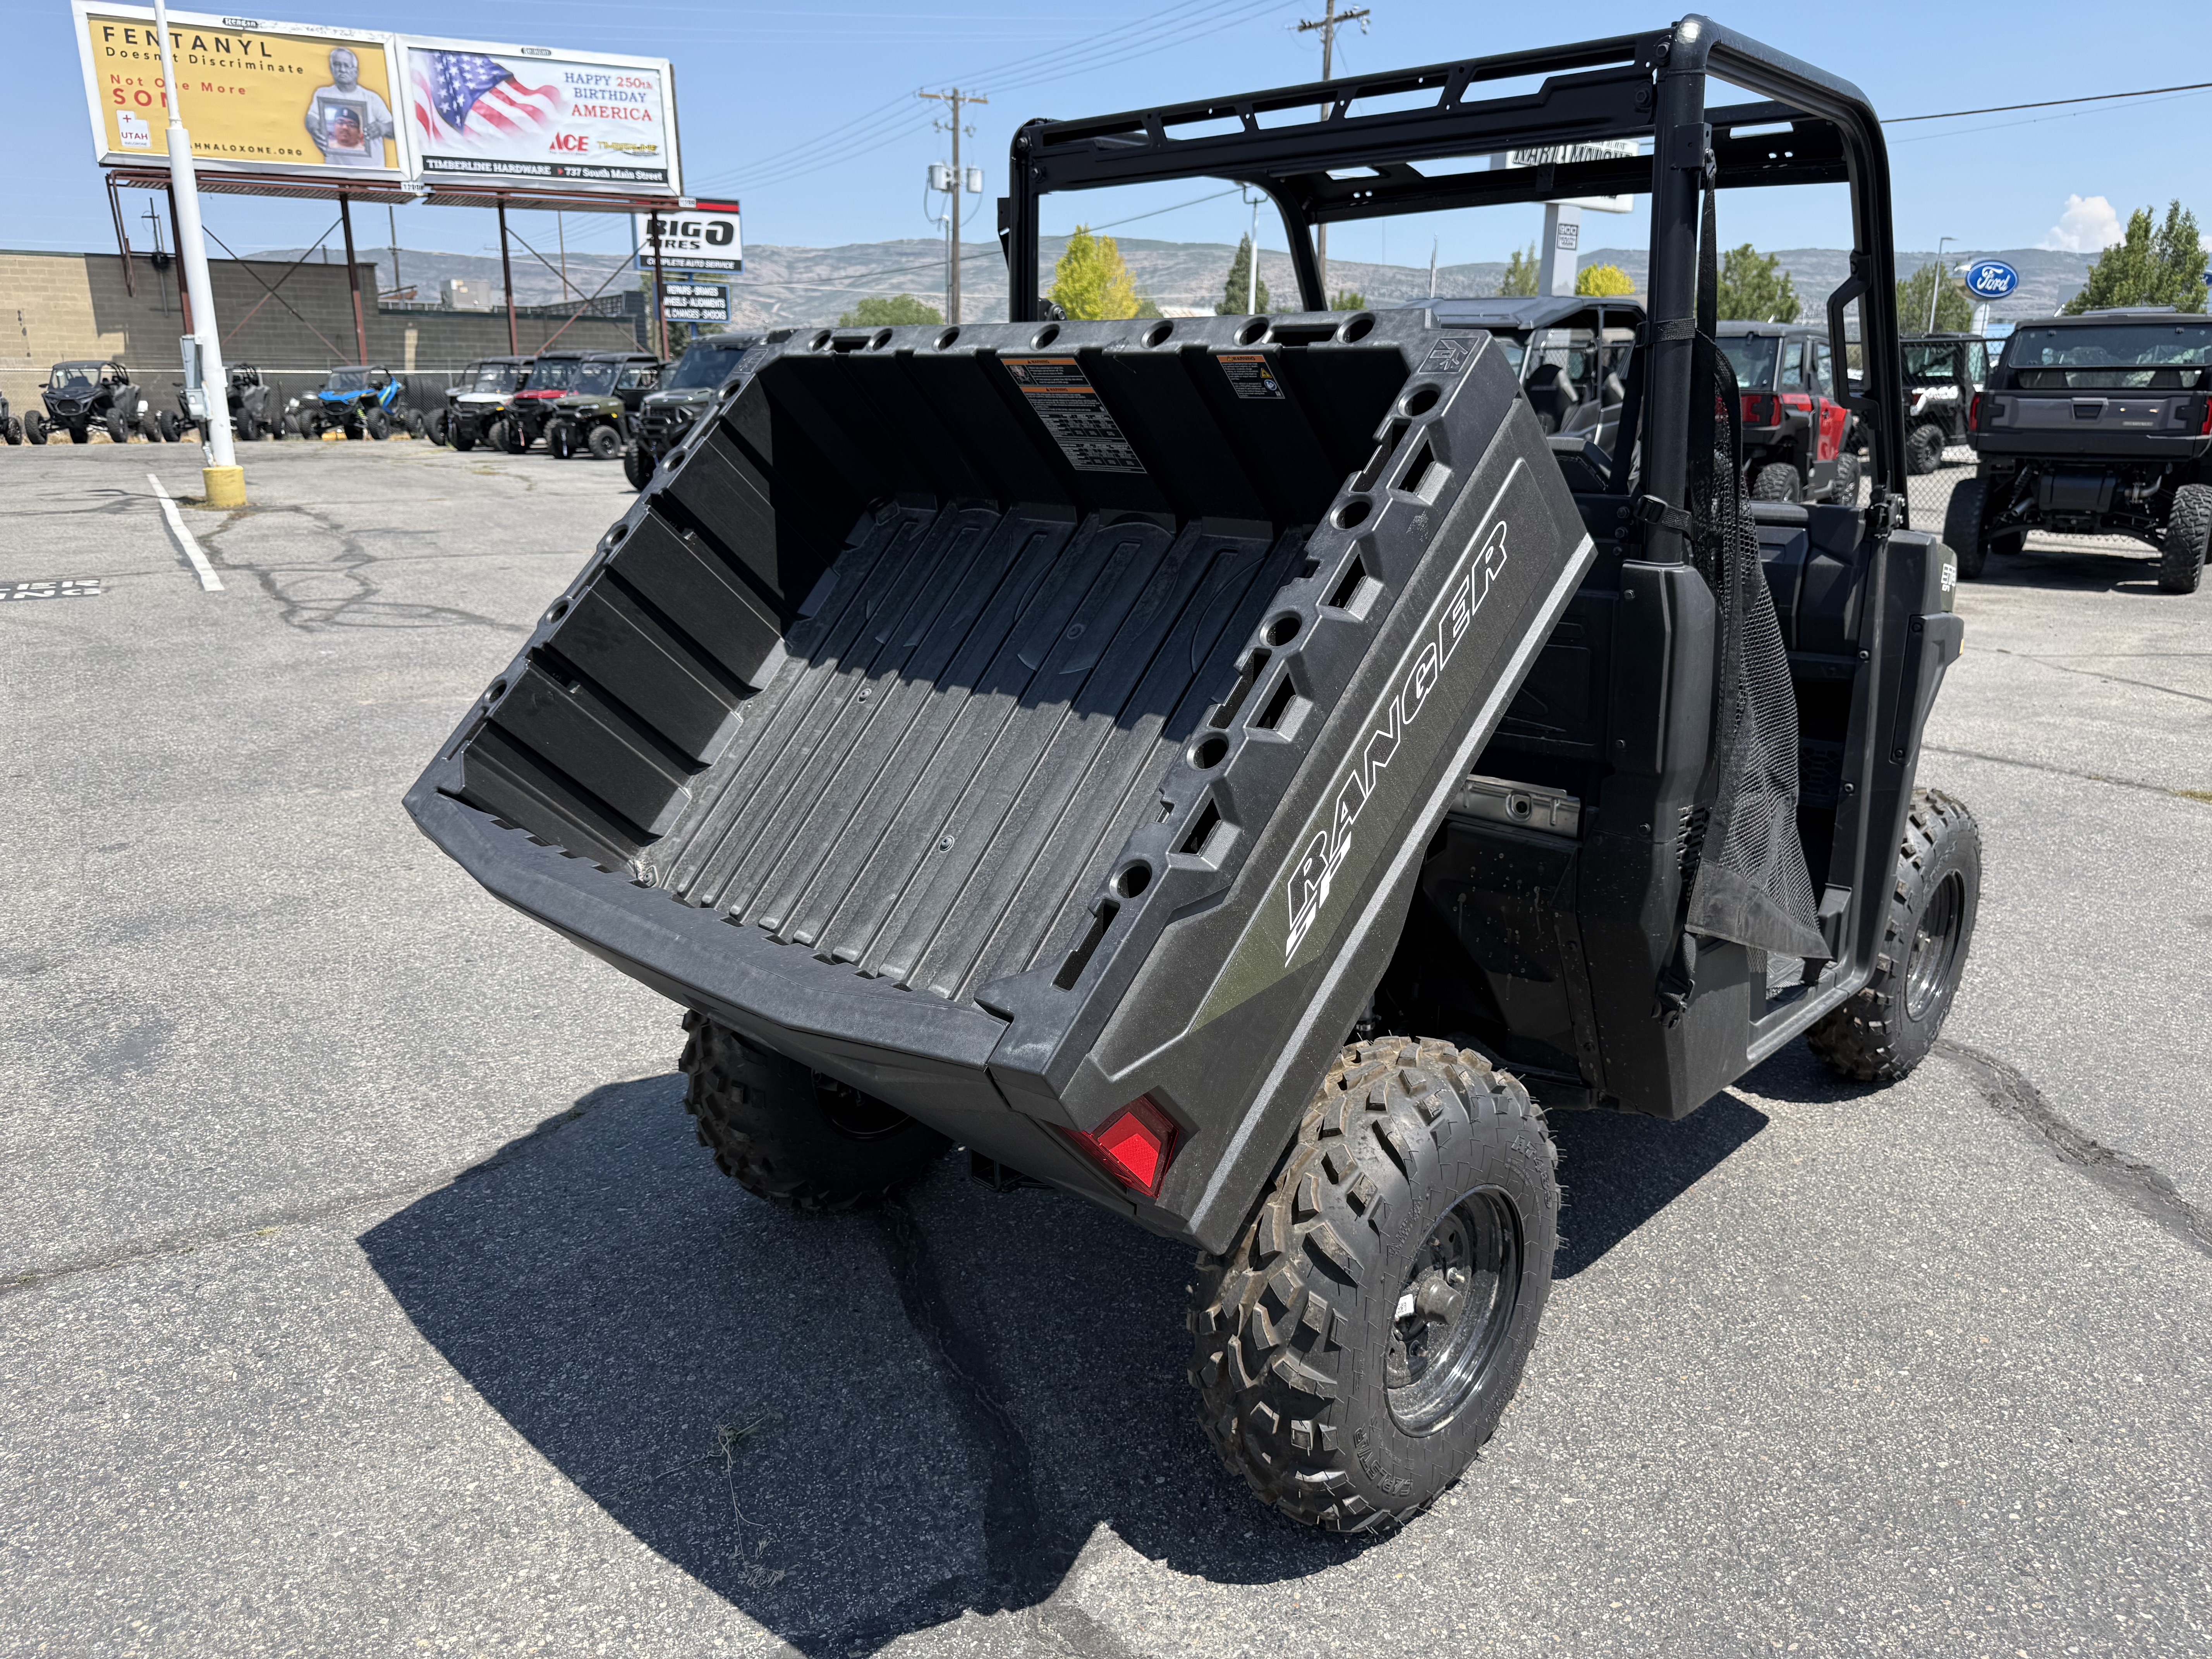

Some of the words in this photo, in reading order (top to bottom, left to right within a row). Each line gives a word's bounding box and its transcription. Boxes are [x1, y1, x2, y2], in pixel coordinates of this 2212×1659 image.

[103, 26, 272, 58] FENTANYL
[106, 46, 178, 63] Doesnt
[189, 54, 304, 74] Discriminate
[110, 74, 143, 86] Not
[201, 82, 246, 95] More
[565, 72, 611, 86] HAPPY
[574, 88, 646, 103] BIRTHDAY
[572, 104, 653, 121] AMERICA
[121, 132, 148, 140] UTAH
[550, 132, 589, 152] ACE
[426, 159, 492, 172] TIMBERLINE
[493, 163, 551, 175] HARDWARE
[564, 167, 581, 177] 737
[582, 168, 610, 178] South
[610, 168, 635, 179] Main
[635, 170, 663, 181] Street
[646, 220, 702, 237] BIG
[706, 221, 734, 245] O
[685, 259, 705, 268] AUTO
[705, 260, 735, 269] SERVICE
[1977, 266, 2011, 292] Ford
[1288, 521, 1507, 930] RANGER
